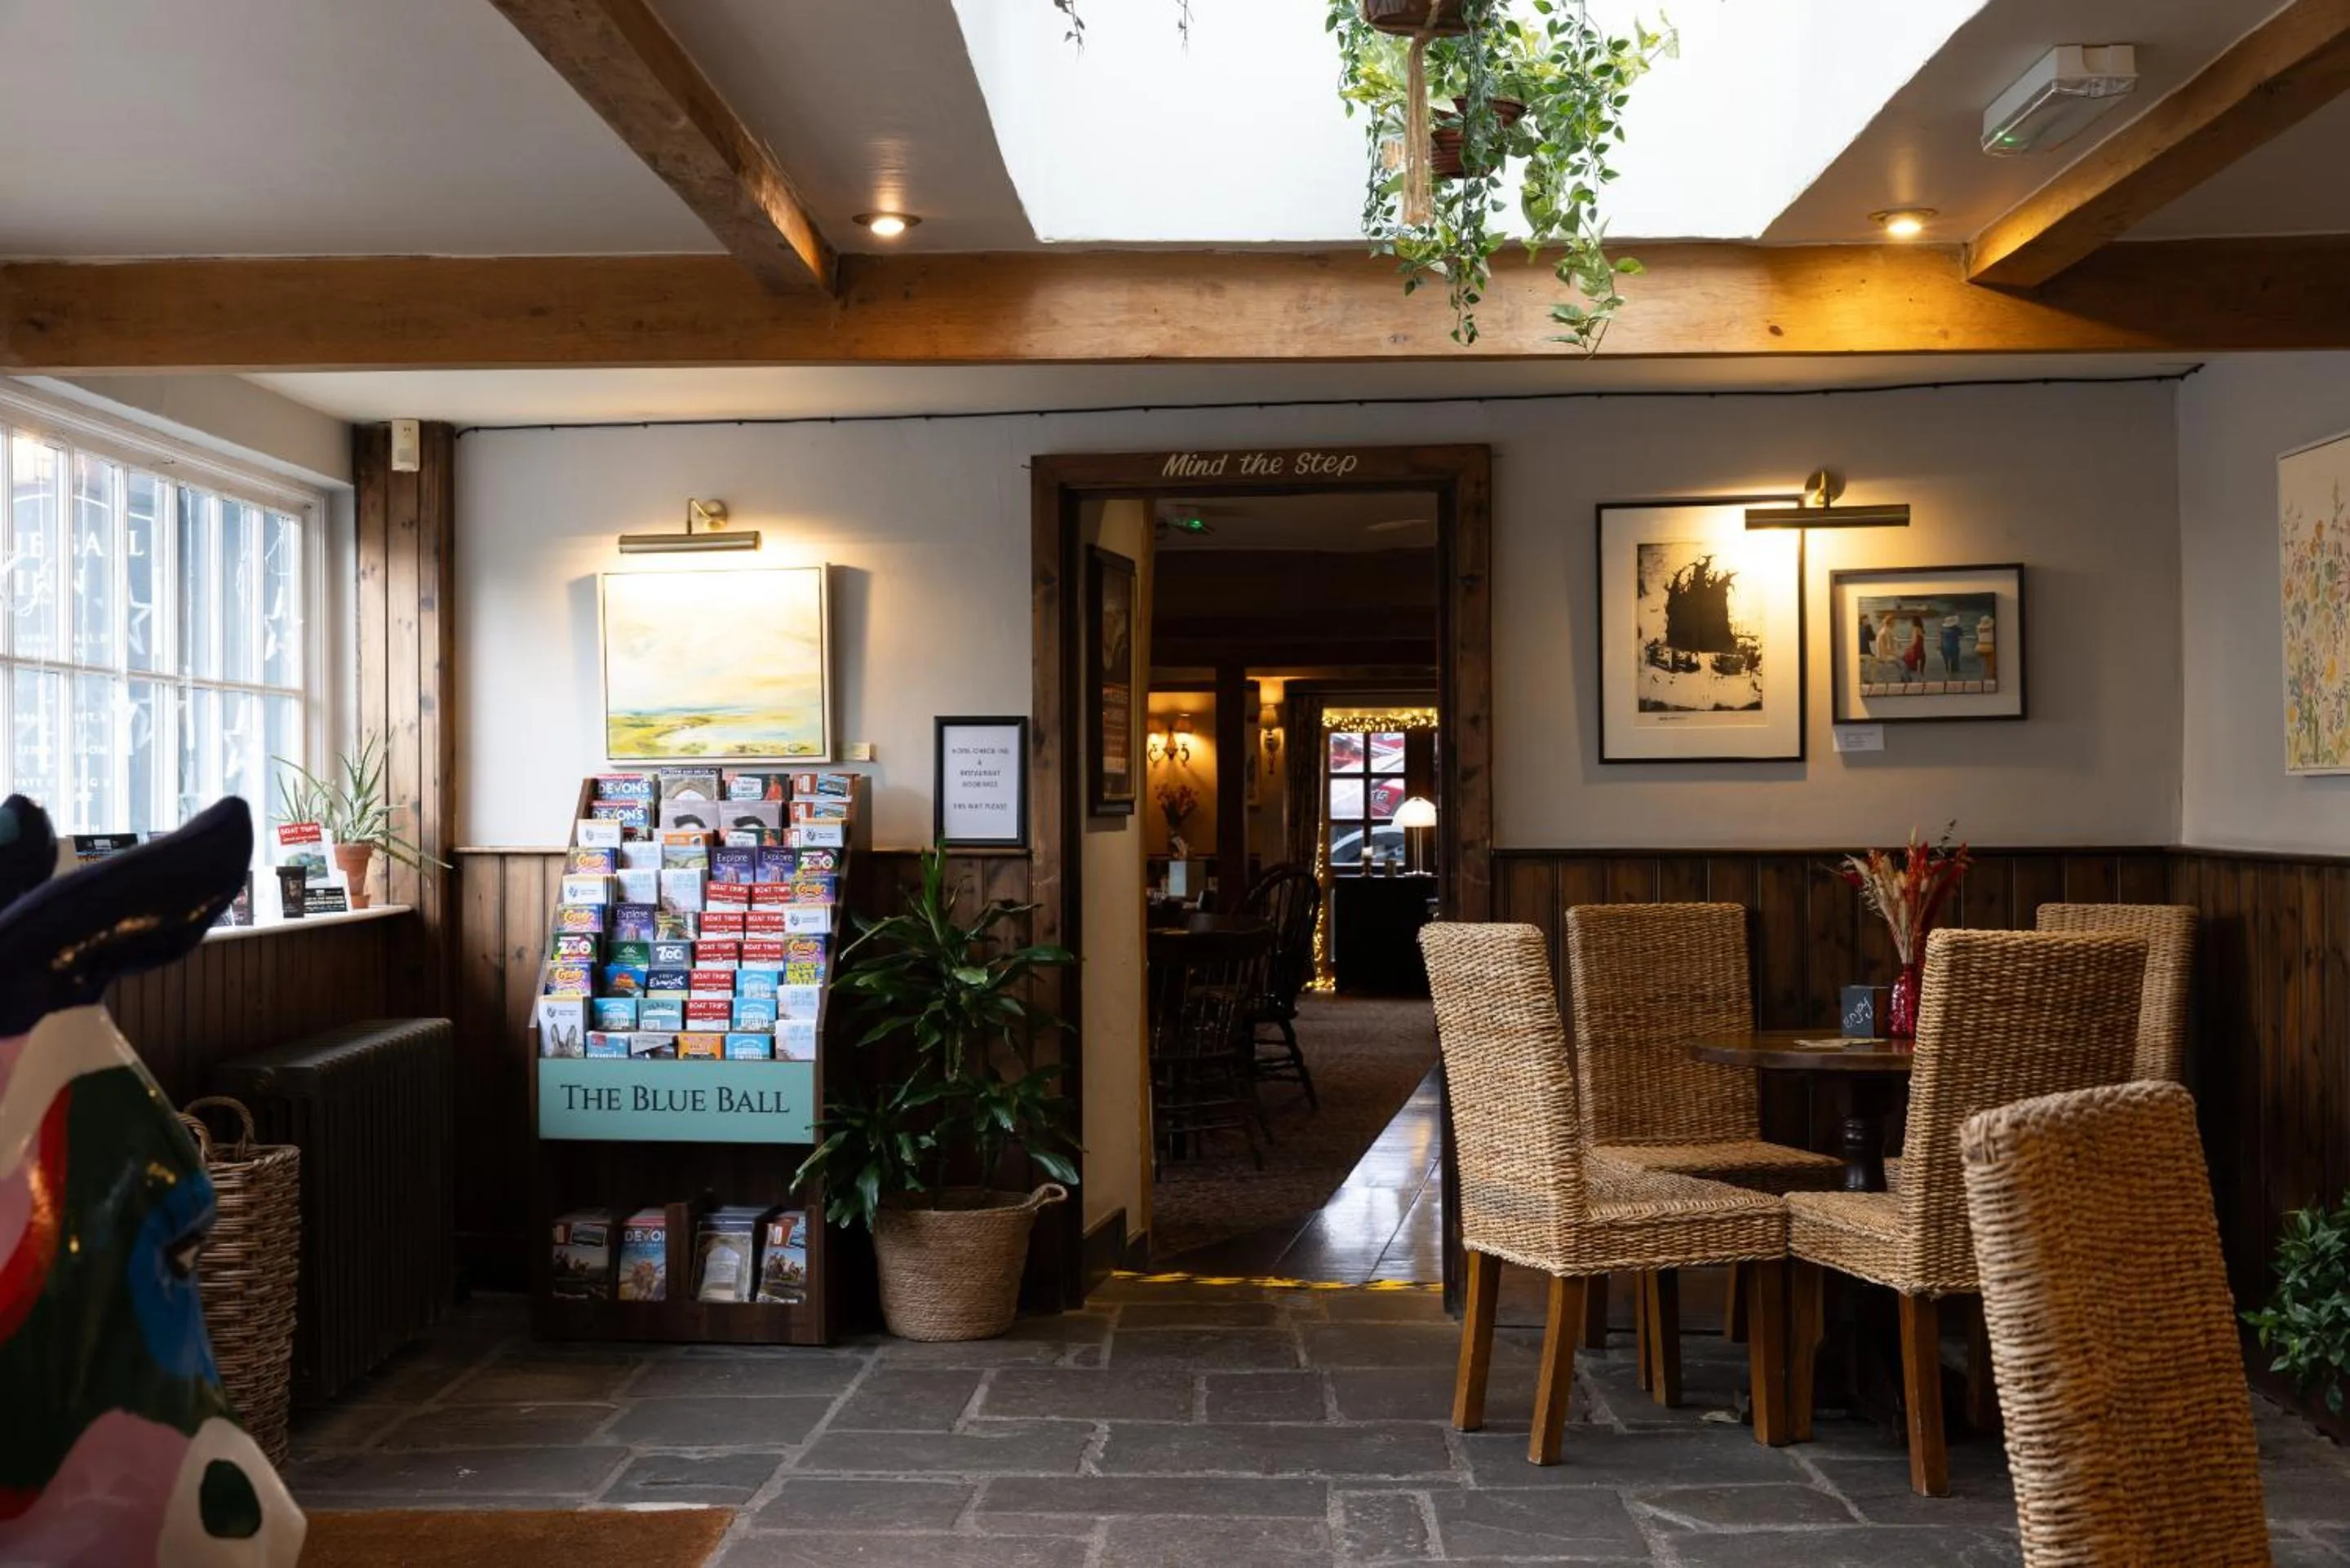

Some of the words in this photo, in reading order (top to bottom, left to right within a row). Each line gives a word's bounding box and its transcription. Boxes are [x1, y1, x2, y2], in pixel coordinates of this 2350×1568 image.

[1162, 454, 1229, 477] Mind
[1239, 453, 1284, 476] the
[1295, 452, 1358, 477] Step
[716, 853, 749, 863] Explore
[761, 852, 794, 863] Explore
[616, 910, 649, 919] Explore
[1843, 996, 1873, 1028] enjoy
[560, 1083, 623, 1111] THE
[632, 1084, 707, 1113] BLUE
[716, 1086, 791, 1114] BALL
